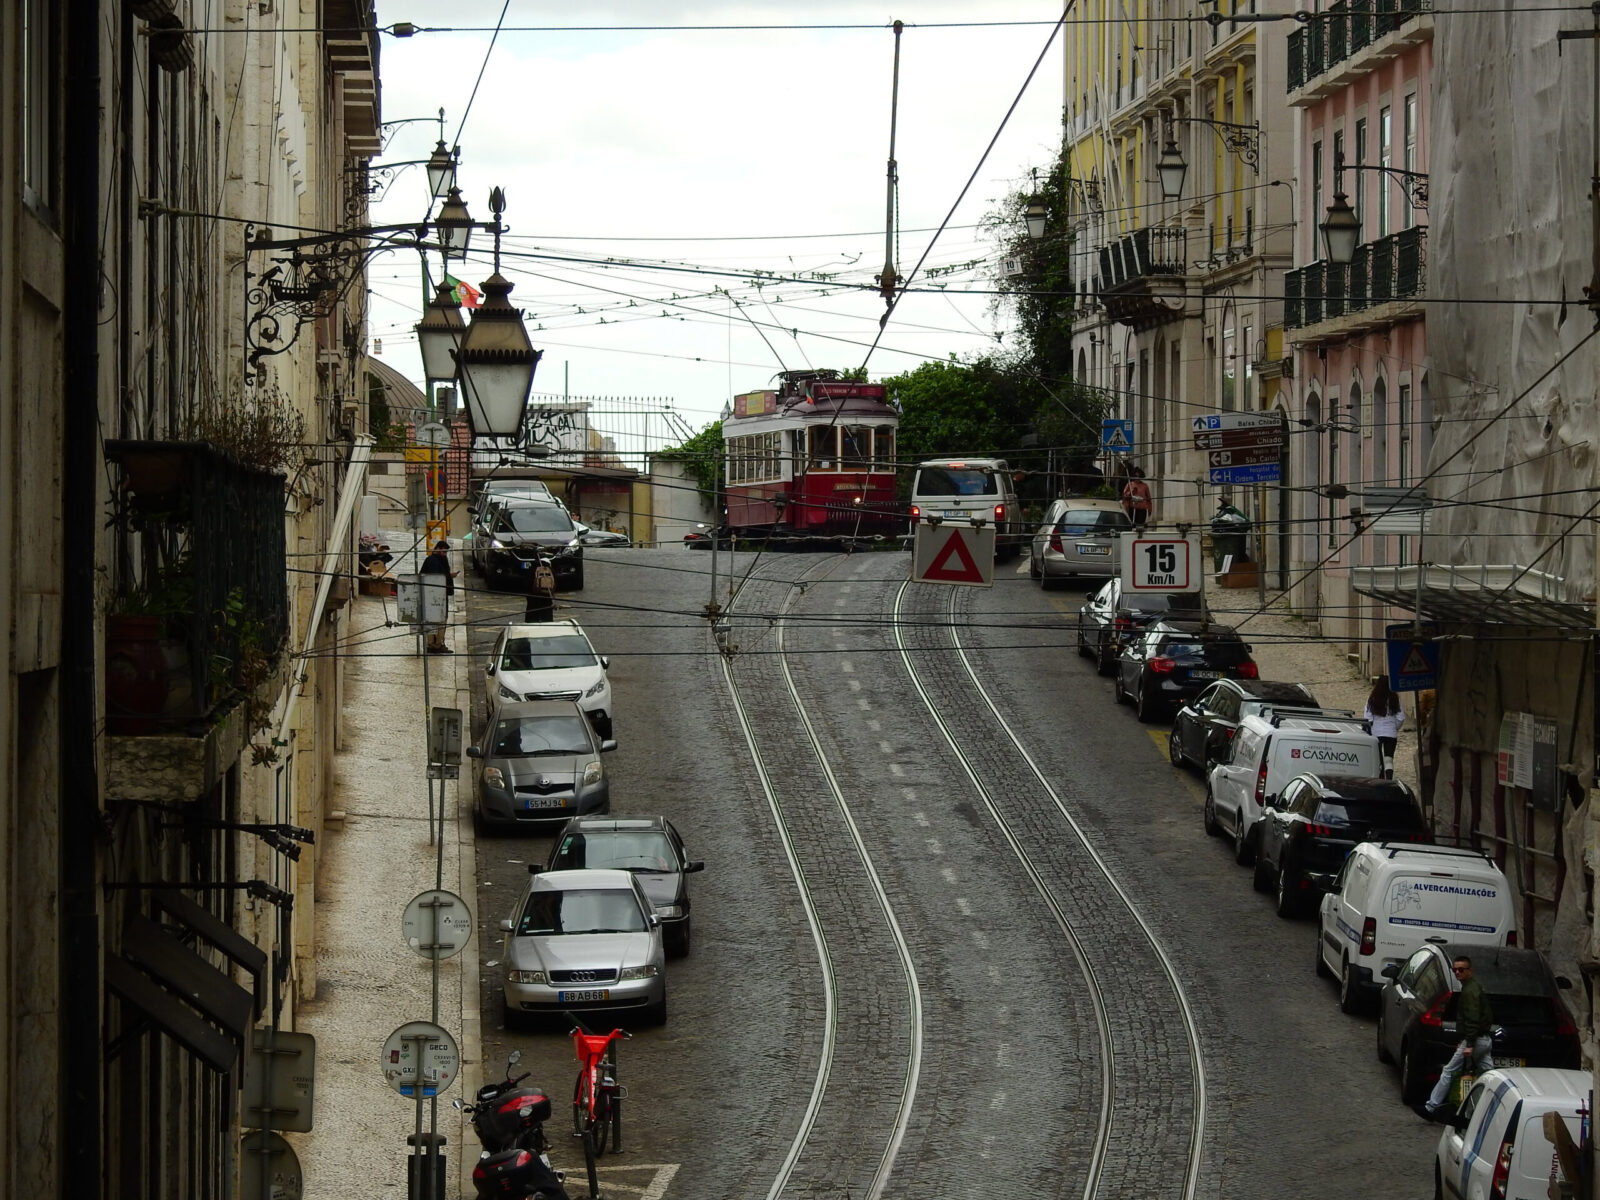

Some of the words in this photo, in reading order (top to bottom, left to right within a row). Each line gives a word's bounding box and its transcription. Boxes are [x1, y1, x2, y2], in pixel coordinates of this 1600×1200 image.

[1210, 419, 1218, 428] P
[1258, 418, 1281, 426] Chiado
[1257, 437, 1282, 445] Chiado
[1223, 470, 1232, 481] H
[1145, 544, 1176, 573] 15
[1147, 573, 1175, 585] Km/h
[1398, 677, 1434, 689] Escola
[1302, 749, 1359, 763] CASANOVA
[1413, 883, 1496, 899] ALVERCANALIZAÇÕES
